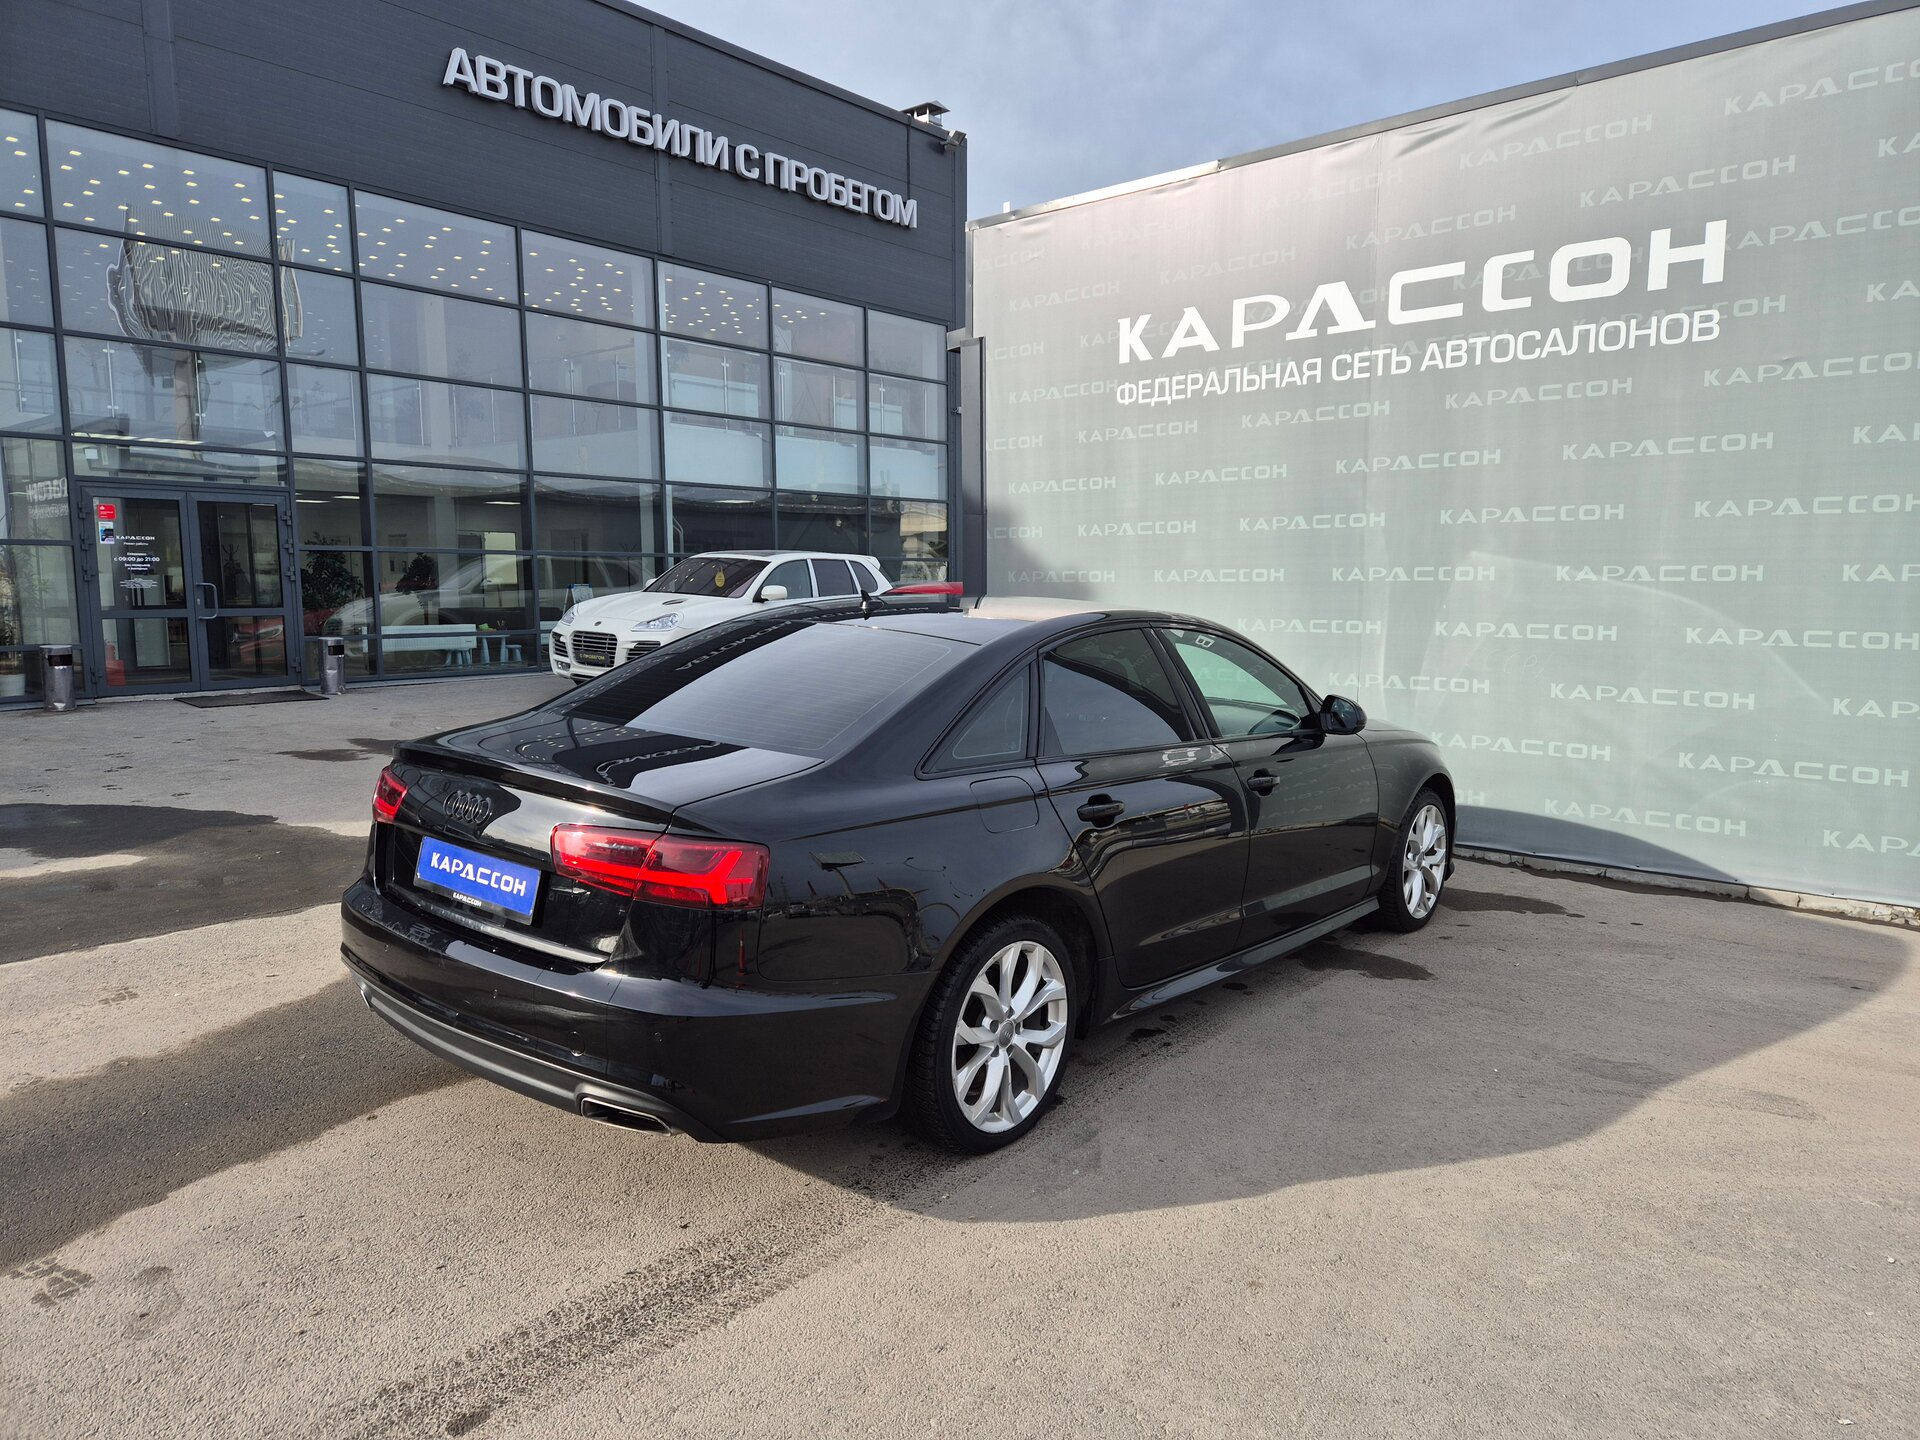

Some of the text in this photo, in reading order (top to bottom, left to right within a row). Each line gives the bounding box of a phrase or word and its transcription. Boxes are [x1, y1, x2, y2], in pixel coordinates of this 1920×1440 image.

[443, 47, 918, 230] АВТОМОБИЛИ С ПРОБЕГОМ
[1117, 308, 1721, 406] ФЕДЕРАЛЬНАЯ СЕТЬ АВТОСАЛОНОВ
